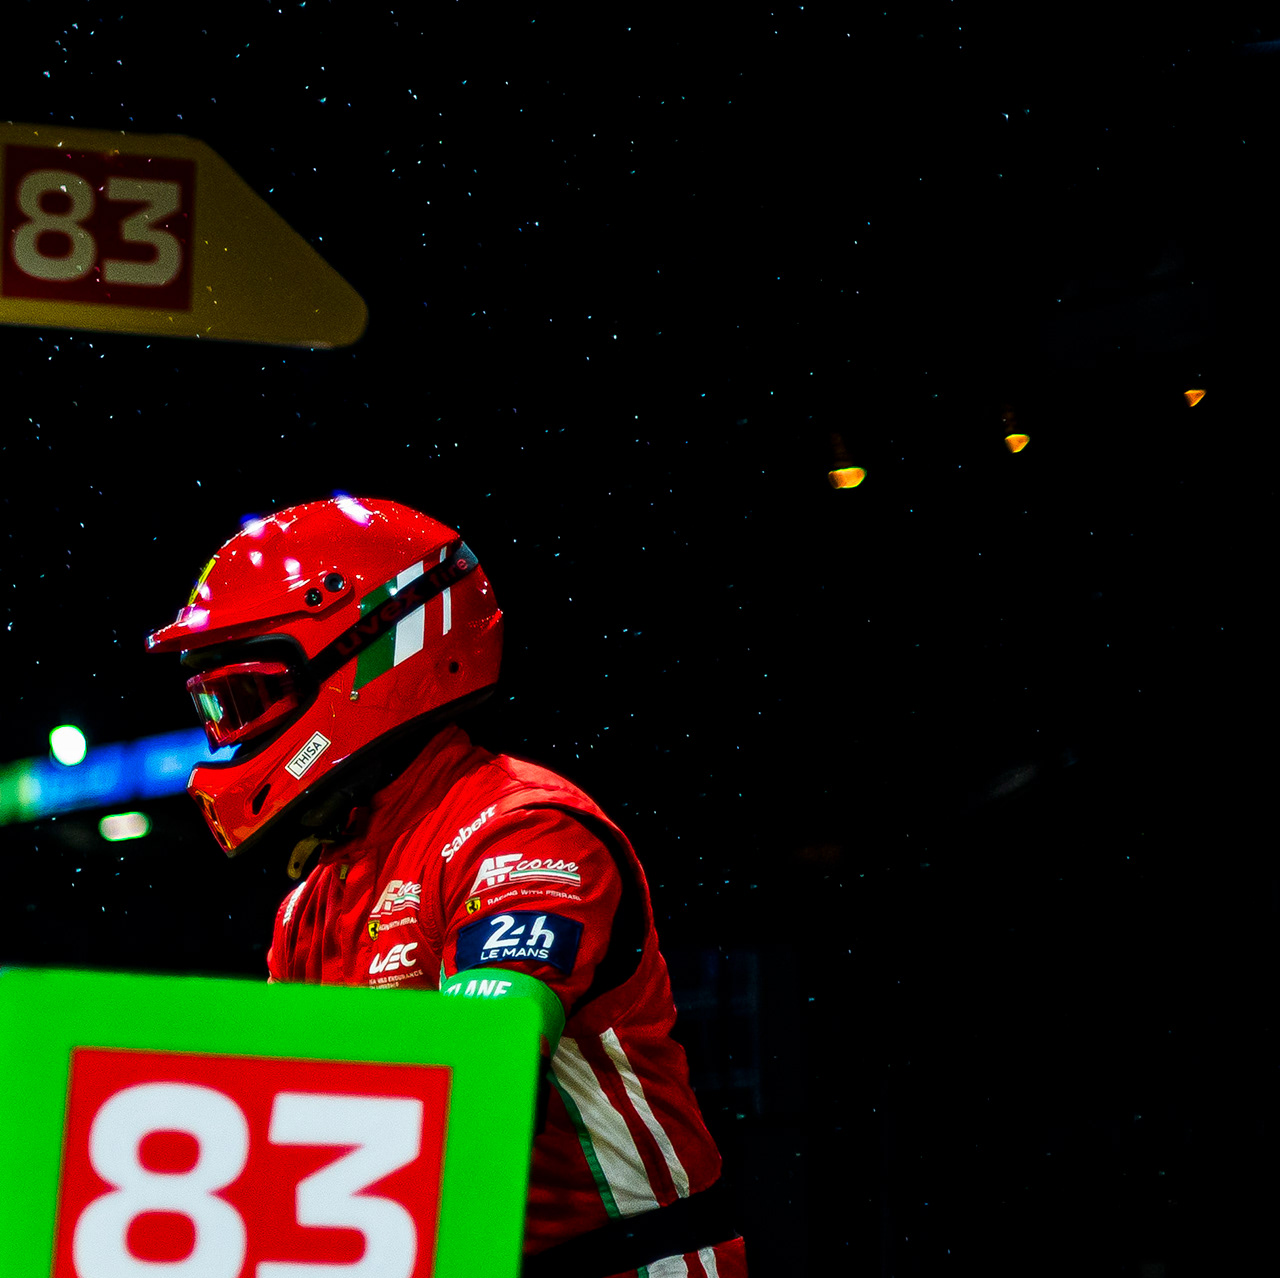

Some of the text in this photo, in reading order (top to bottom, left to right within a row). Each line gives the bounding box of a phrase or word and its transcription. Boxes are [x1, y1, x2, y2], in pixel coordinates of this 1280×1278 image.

[13, 168, 182, 287] 83
[337, 588, 423, 656] uvex
[293, 741, 322, 770] THISA
[441, 803, 498, 863] Sabelt
[469, 853, 579, 895] AF corse
[369, 942, 418, 975] WEC
[480, 947, 550, 961] LE MANS
